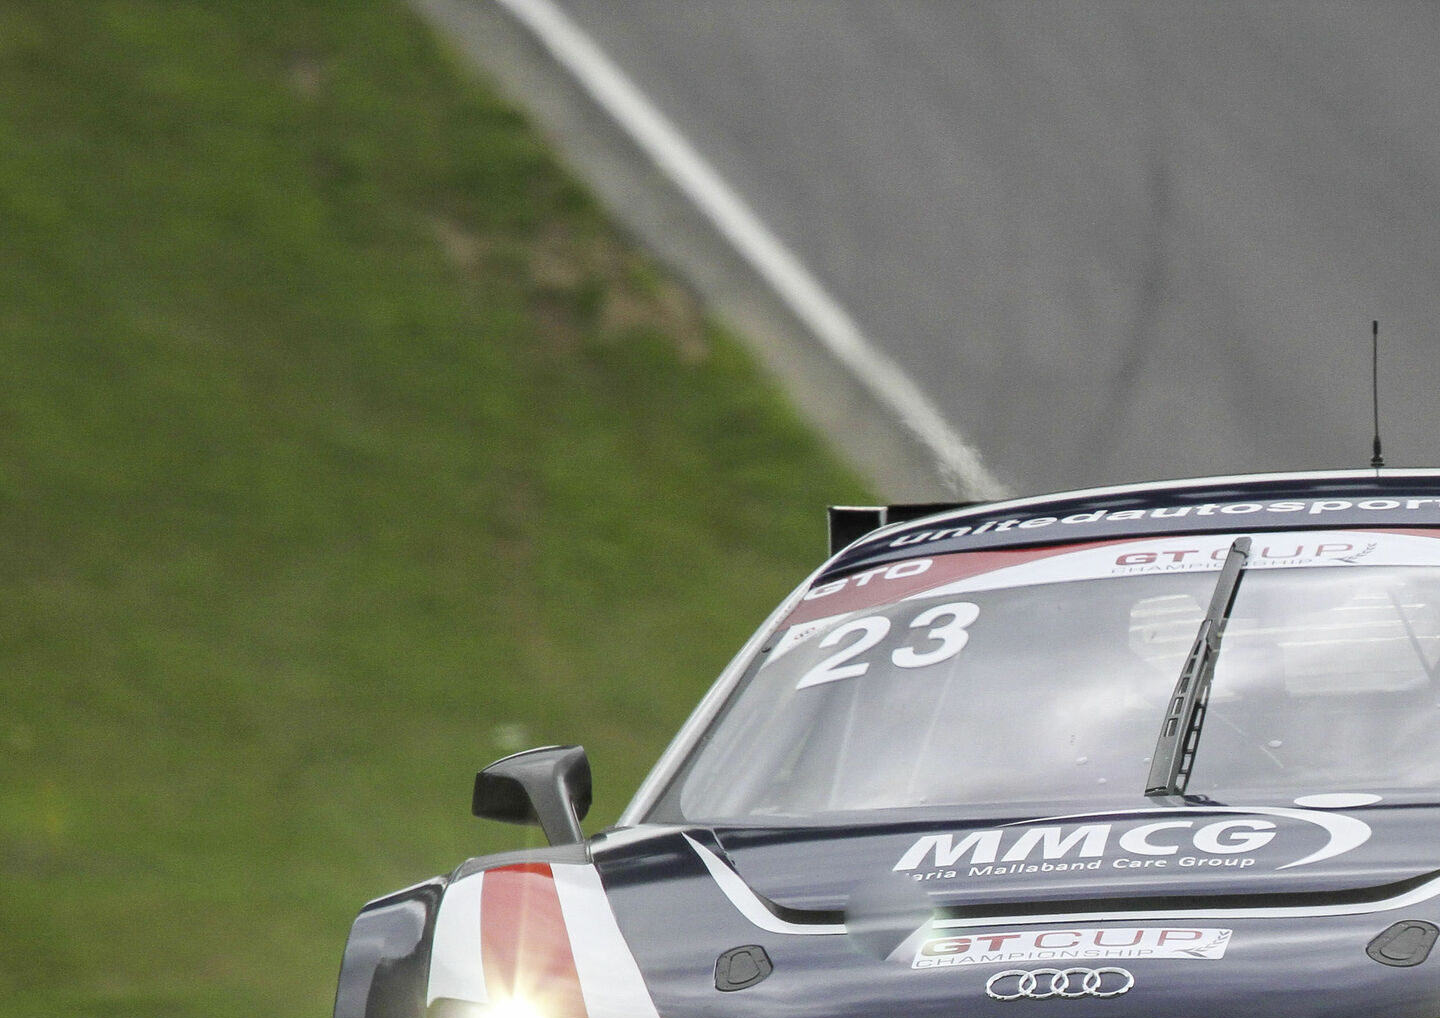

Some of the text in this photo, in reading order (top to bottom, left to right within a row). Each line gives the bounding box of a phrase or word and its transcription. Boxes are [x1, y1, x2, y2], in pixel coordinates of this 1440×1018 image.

[803, 558, 933, 601] GTO
[1111, 558, 1313, 574] CHAMPIOSHIP
[795, 601, 980, 690] 23
[892, 819, 1277, 872] MMCG
[905, 856, 1256, 881] aria Mallaband Care Group
[916, 949, 1154, 968] CHAMPIONSHIP
